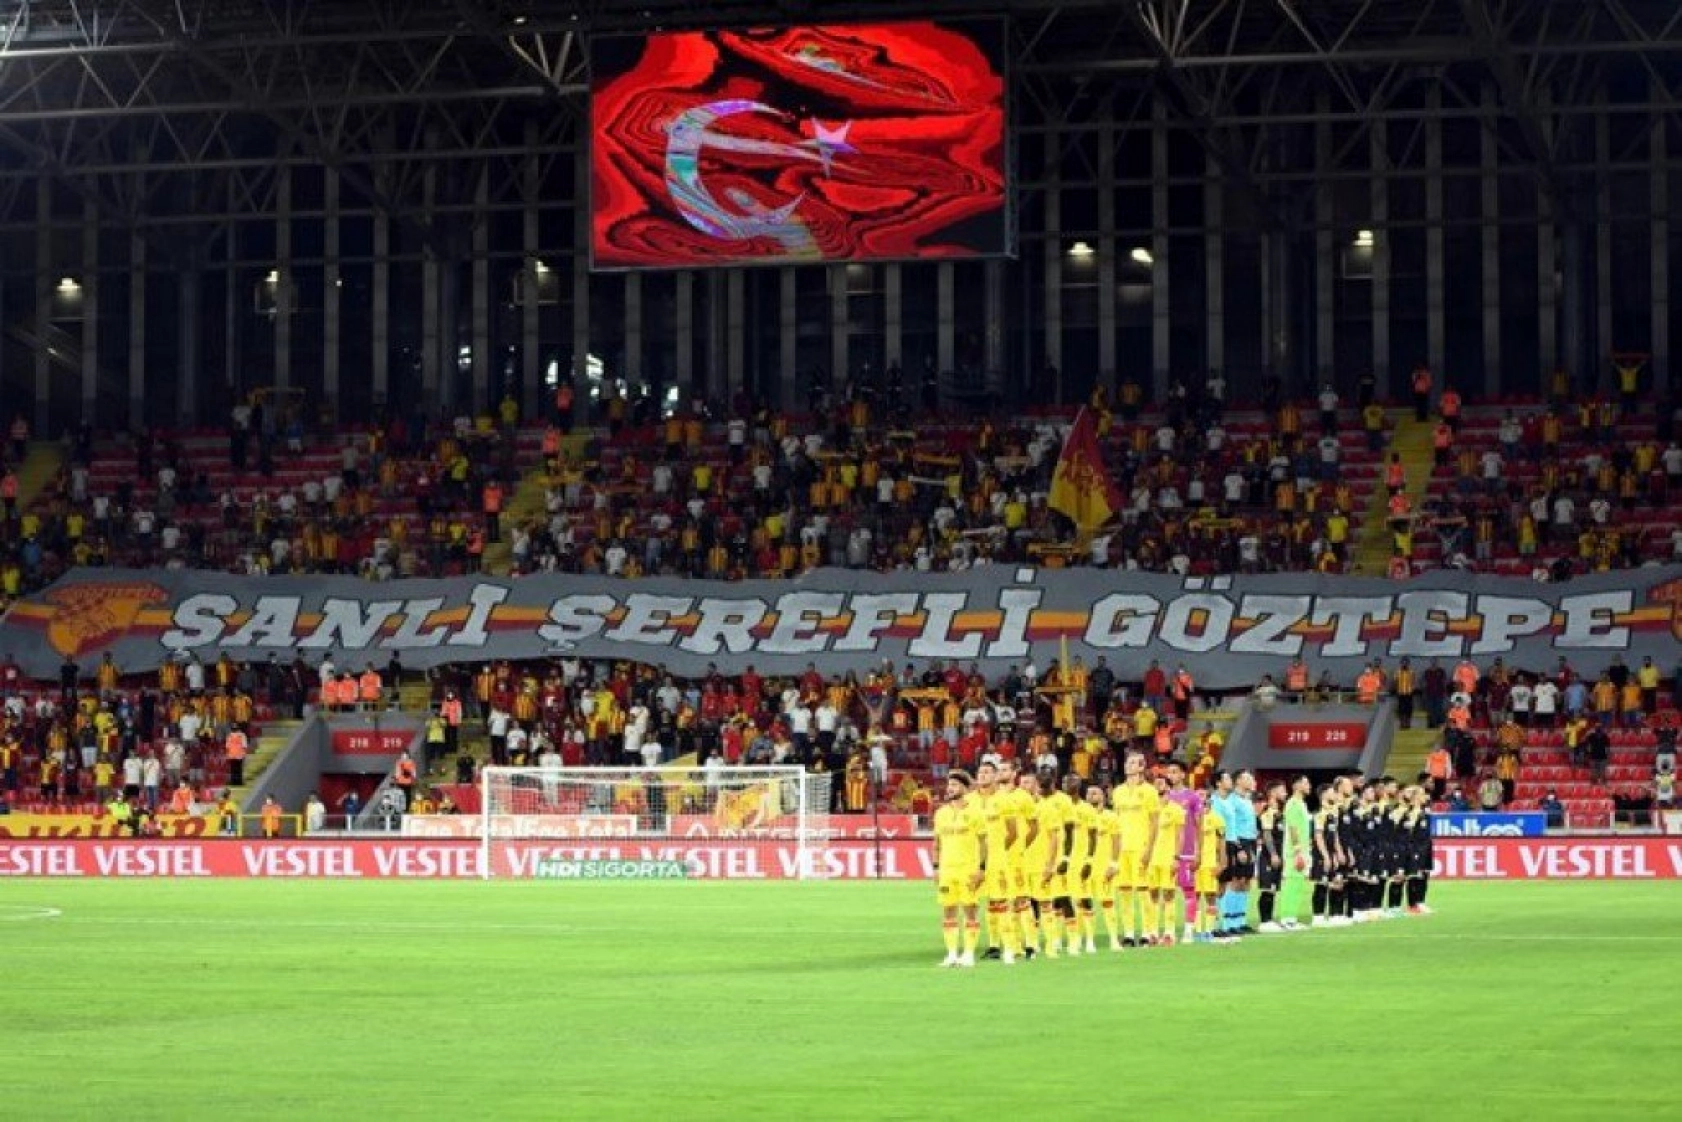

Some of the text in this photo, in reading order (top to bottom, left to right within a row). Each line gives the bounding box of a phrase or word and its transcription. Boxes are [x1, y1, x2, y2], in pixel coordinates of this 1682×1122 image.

[537, 568, 1042, 658] ŞEREFLİ
[1083, 575, 1634, 658] GÖZTEPE
[93, 845, 211, 876] VESTEL
[242, 845, 364, 876] VESTEL
[372, 845, 495, 876] VESTEL
[776, 846, 905, 878] VESTEL
[1518, 845, 1656, 876] VESTEL
[539, 861, 581, 877] HDI
